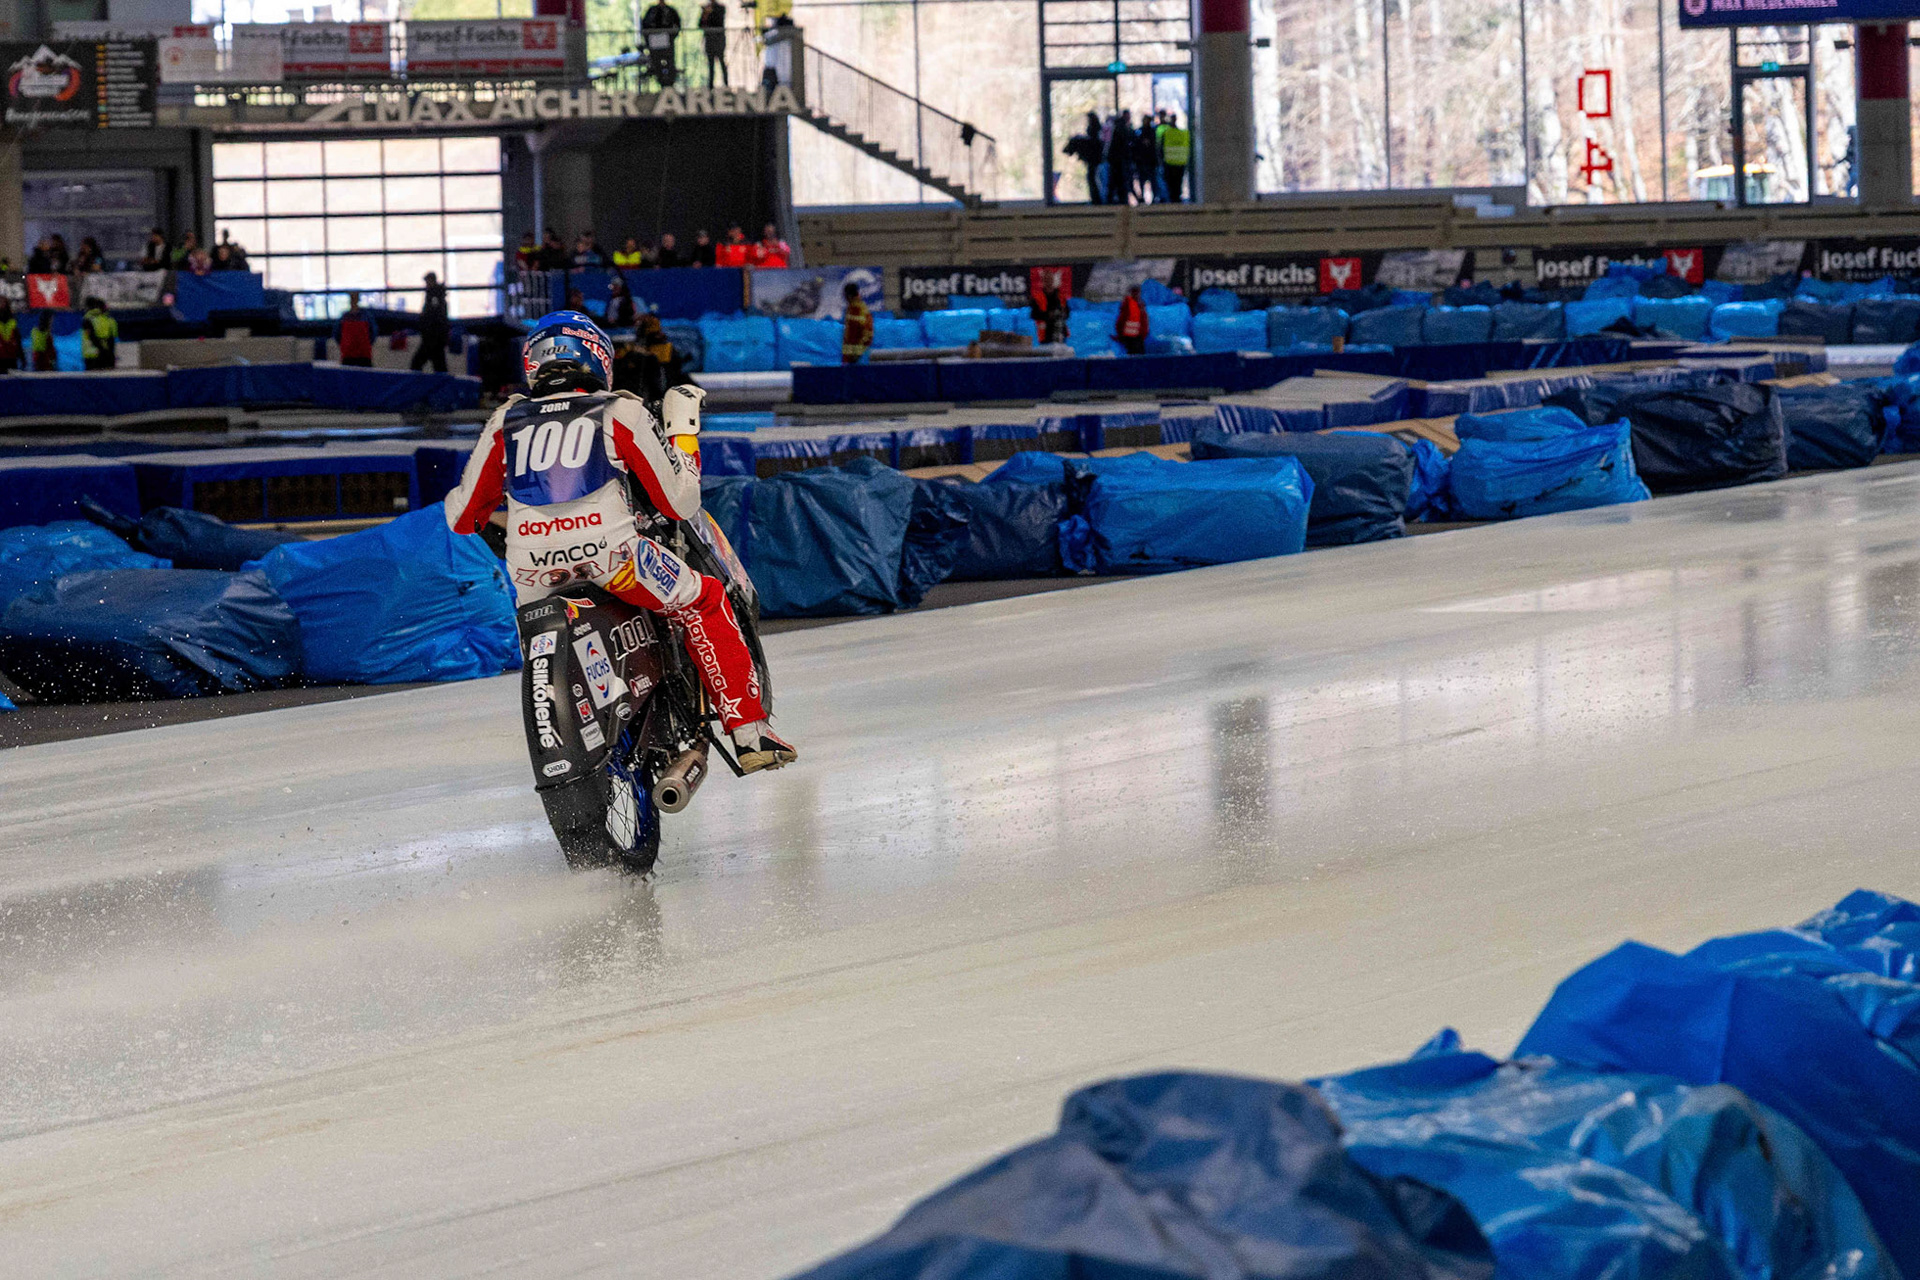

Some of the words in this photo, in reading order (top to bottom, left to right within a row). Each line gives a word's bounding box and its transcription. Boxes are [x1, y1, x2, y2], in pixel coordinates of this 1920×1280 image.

[377, 92, 477, 122] MAX
[489, 88, 640, 121] AICHER
[652, 85, 800, 116] ARENA
[1536, 254, 1594, 281] Josef
[1821, 246, 1879, 273] Josef
[902, 272, 960, 300] Josef
[963, 271, 1027, 294] Fuchs
[1192, 263, 1251, 291] Josef
[1253, 262, 1317, 286] Fuchs
[539, 401, 571, 414] ZORN
[512, 416, 596, 477] 100
[518, 512, 603, 537] daytona
[529, 542, 598, 567] WACO
[609, 615, 650, 661] 100
[586, 657, 611, 683] FUCHS
[532, 657, 556, 749] Silkolene
